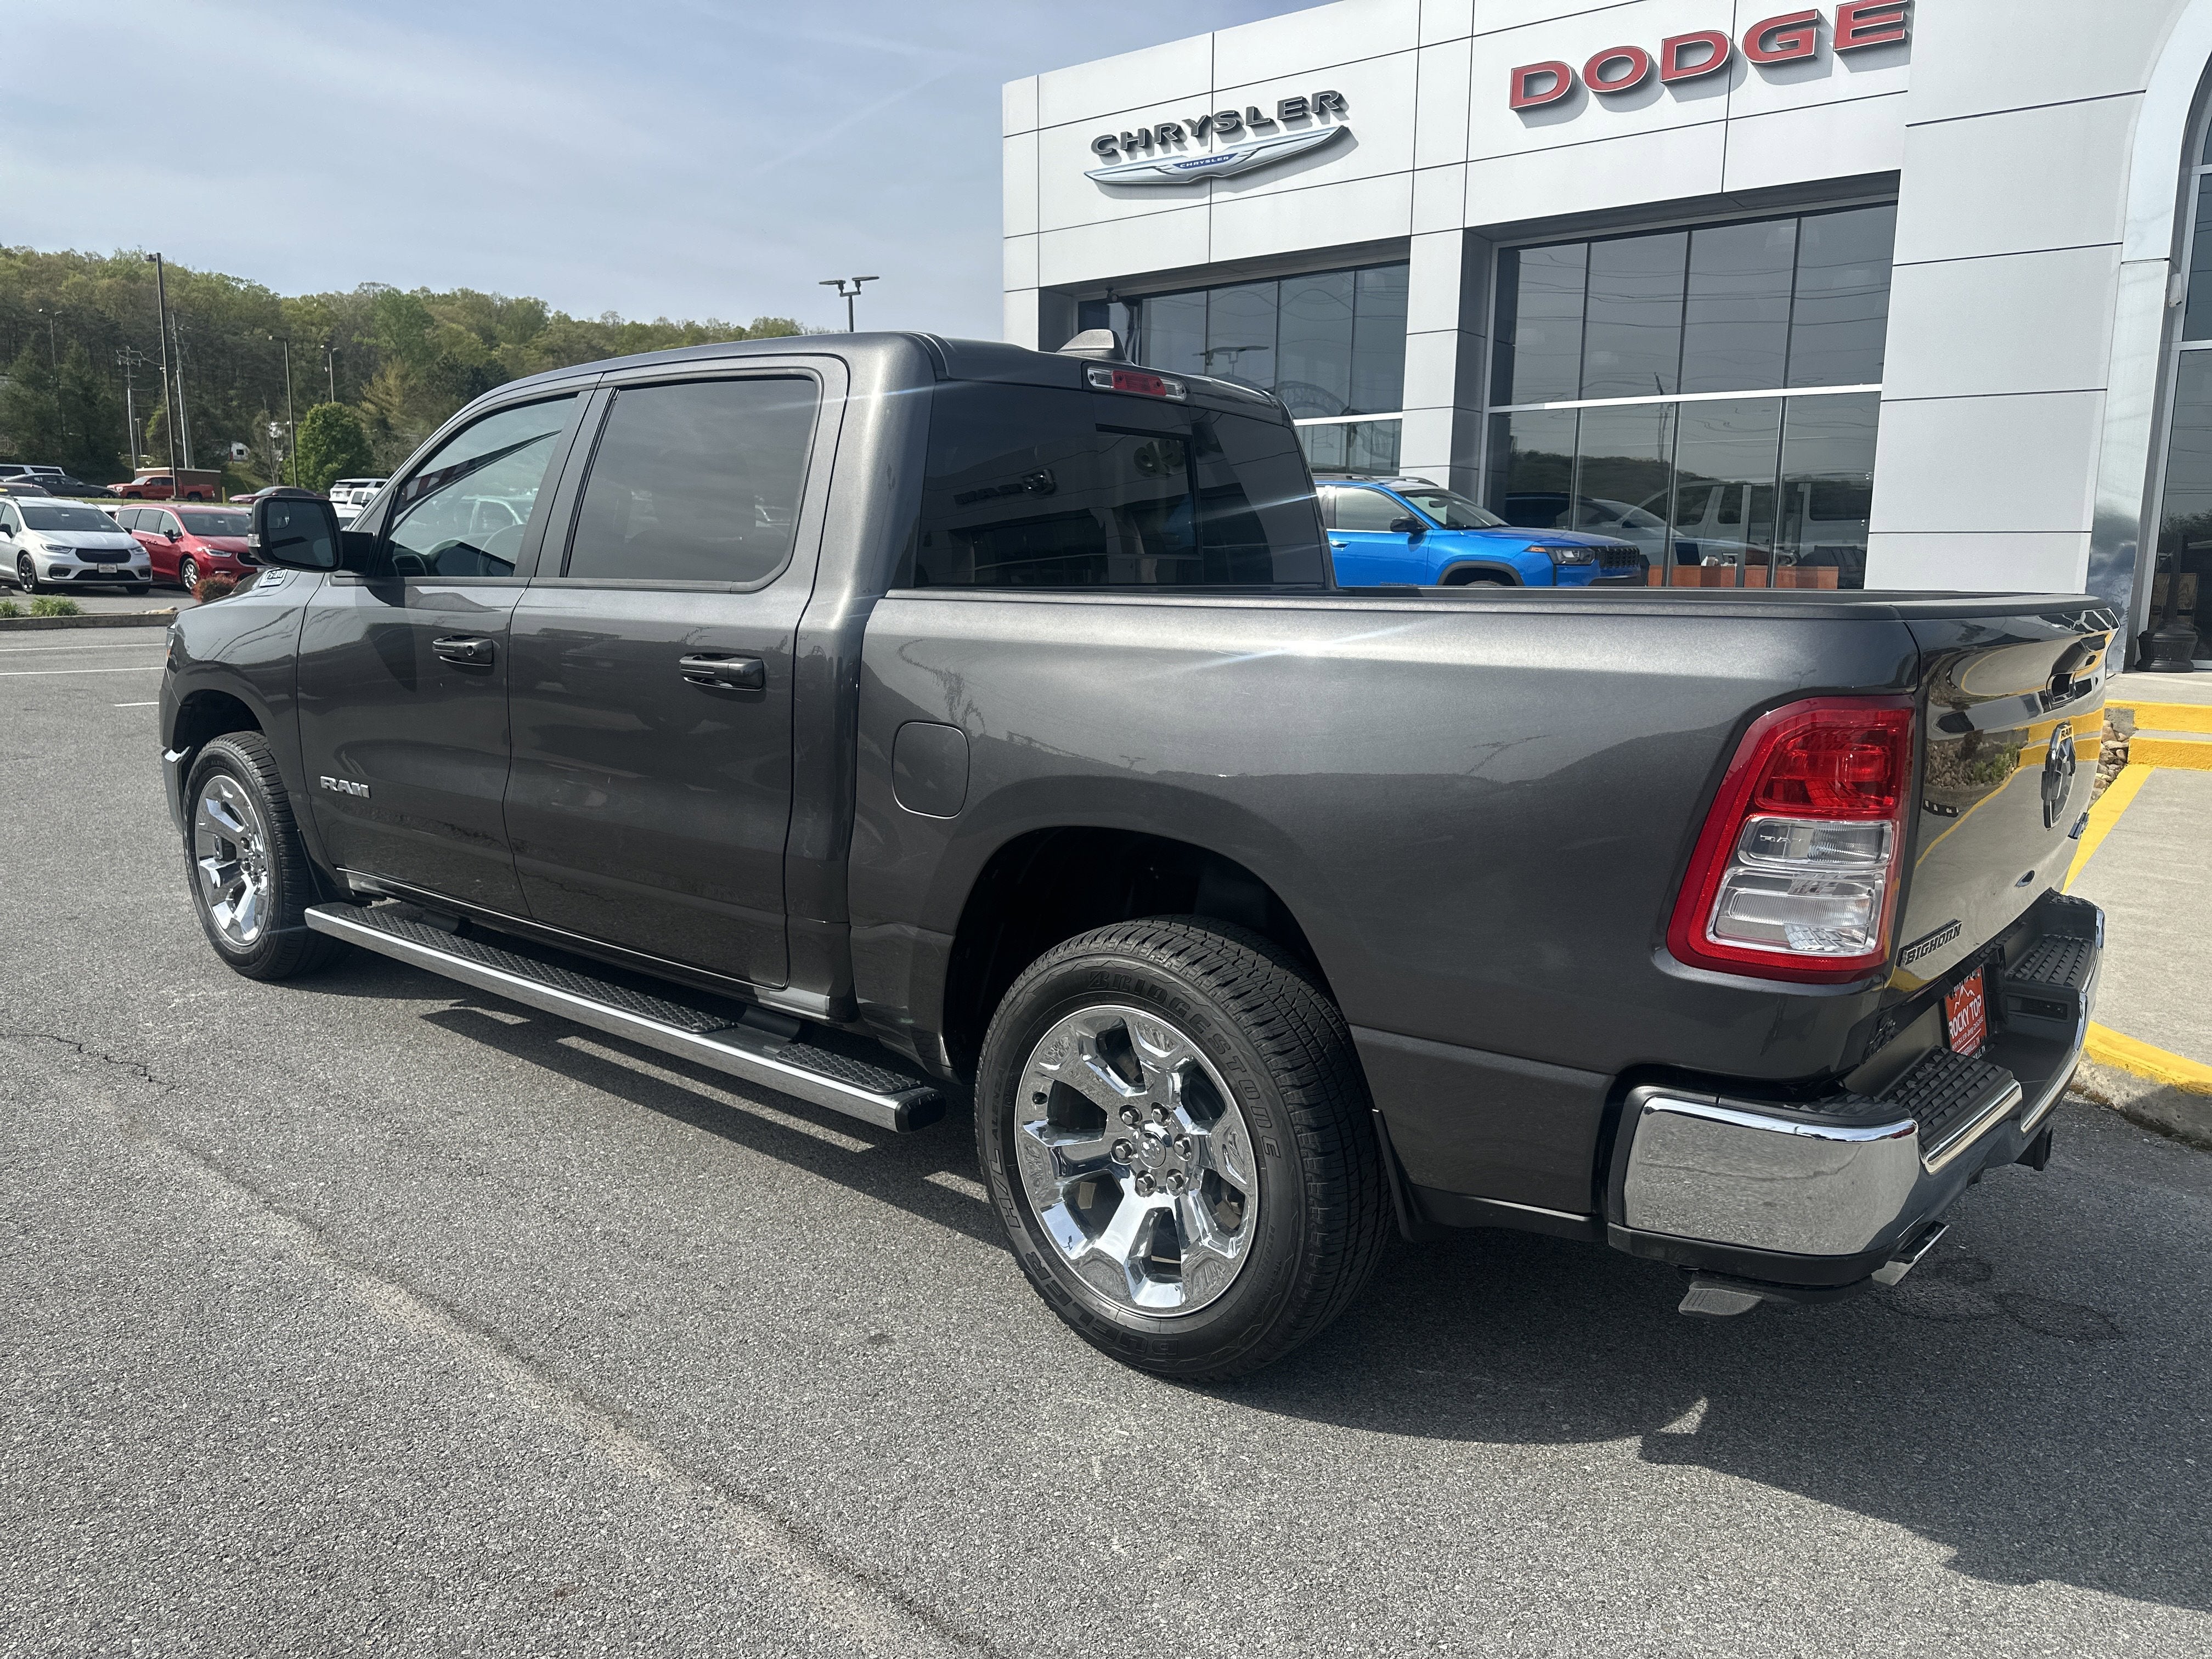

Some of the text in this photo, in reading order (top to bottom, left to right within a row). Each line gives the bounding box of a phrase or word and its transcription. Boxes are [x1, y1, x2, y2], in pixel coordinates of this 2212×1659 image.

[1510, 0, 1908, 110] DODGE
[1091, 90, 1342, 155] CHRYSLER
[1180, 156, 1229, 168] CHRYSLER
[2061, 726, 2072, 739] RAM
[320, 776, 370, 799] RAM
[1904, 921, 1963, 966] BIGHORN
[1949, 995, 1982, 1039] ROCKY TOP
[1088, 970, 1281, 1159] BRIDGESTONE
[1025, 1251, 1179, 1355] DUELER
